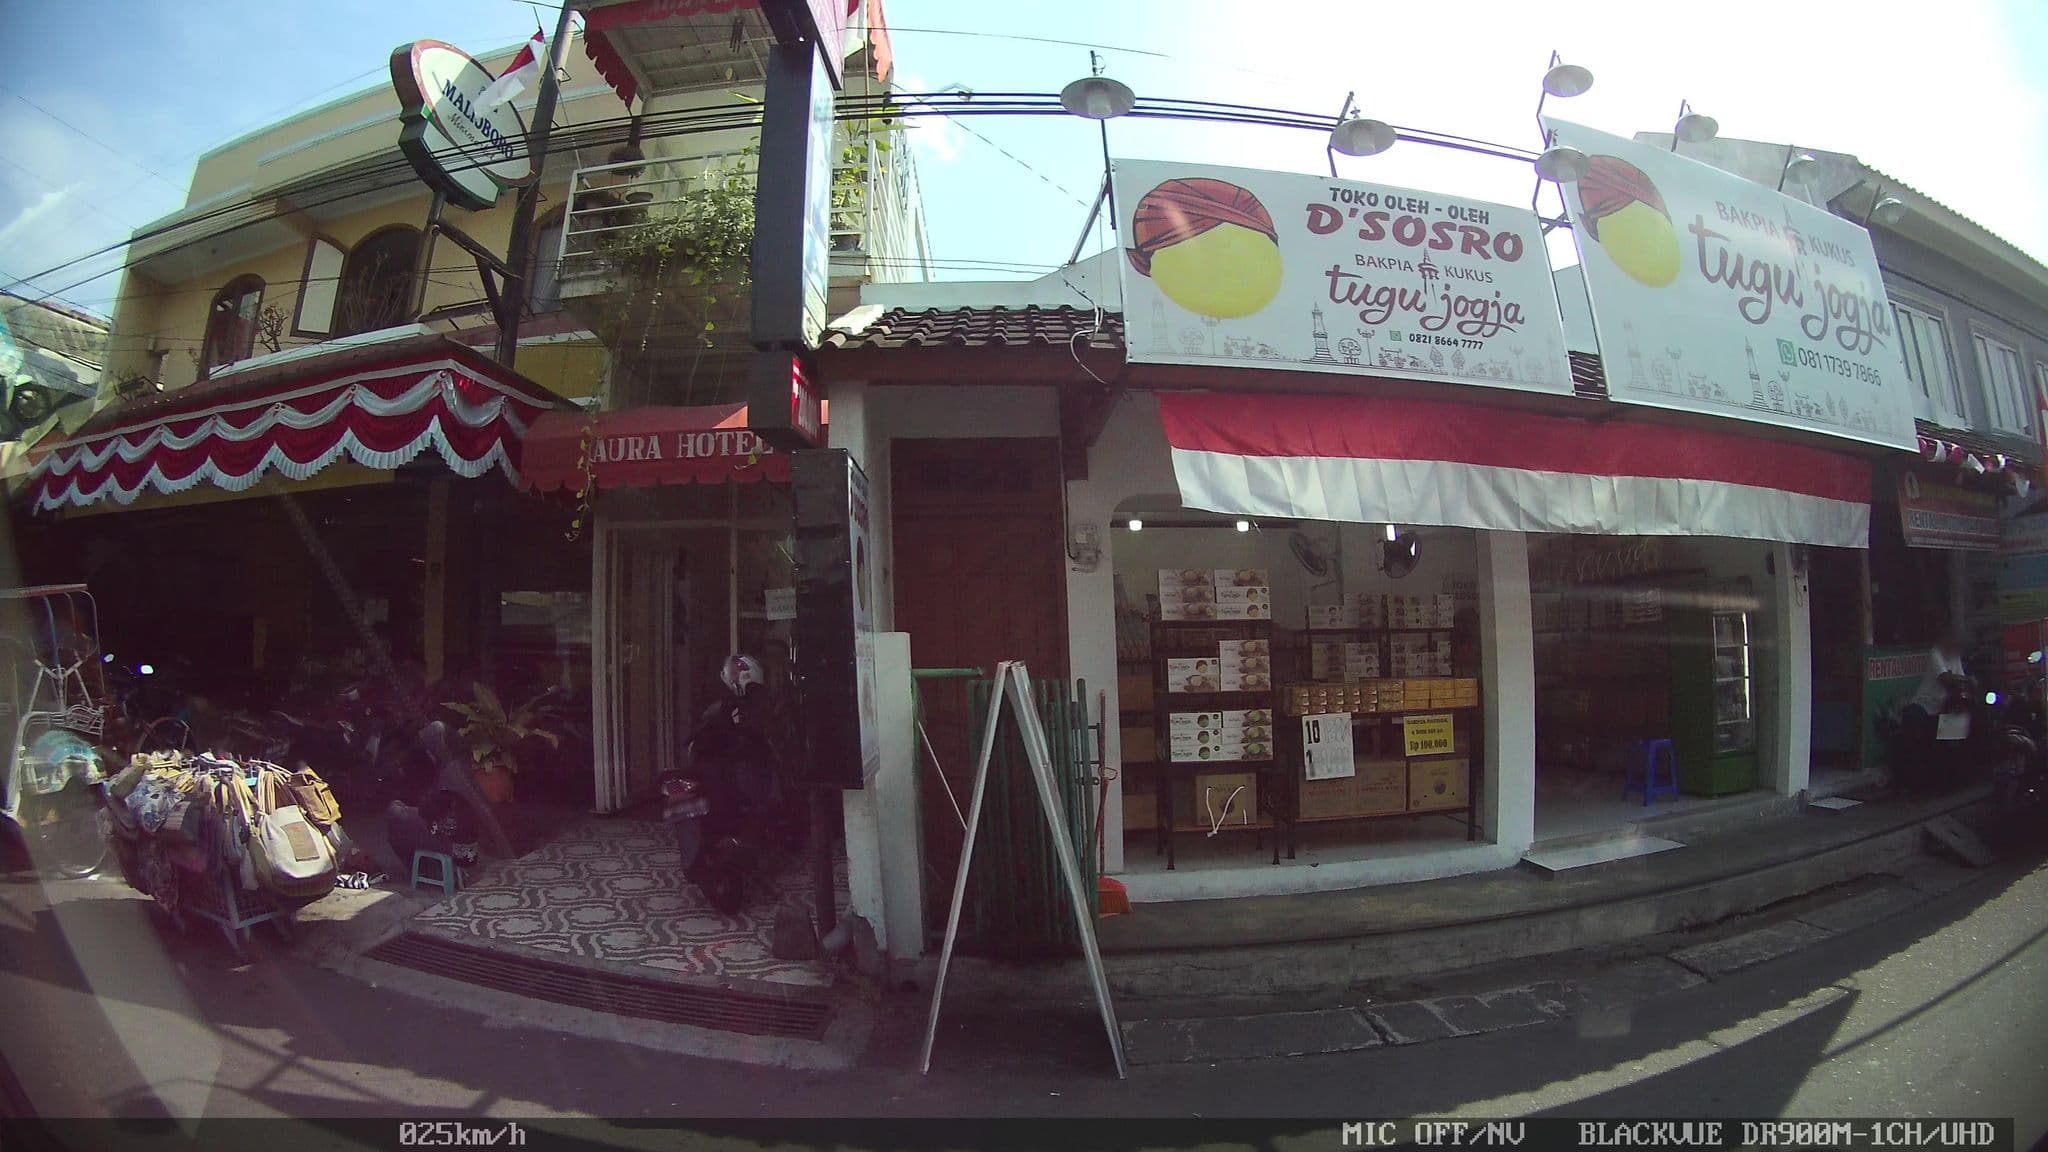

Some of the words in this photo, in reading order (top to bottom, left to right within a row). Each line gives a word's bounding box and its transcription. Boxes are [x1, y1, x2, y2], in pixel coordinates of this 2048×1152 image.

[1329, 187, 1379, 207] TOKO
[1384, 195, 1429, 215] OLEH
[1447, 205, 1490, 225] OLEH
[1306, 203, 1524, 262] D'SOSRO
[1715, 201, 1781, 239] BAKPIA
[1808, 234, 1856, 268] KUKUS
[1355, 254, 1414, 273] BAKPIA
[1444, 266, 1494, 284] KUKUS
[1688, 214, 1804, 325] tugu
[1800, 263, 1891, 356] jogja
[1325, 264, 1426, 325] tugu
[1419, 283, 1525, 338] jogja
[1409, 333, 1432, 345] 0821
[1461, 339, 1484, 350] 7777
[1798, 347, 1823, 370] 081
[1824, 354, 1852, 378] 1739
[1852, 362, 1882, 387] 7866
[677, 431, 774, 458] HOTEL
[1305, 719, 1321, 745] 10
[1410, 740, 1419, 752] Rp
[1421, 738, 1447, 750] 100.000
